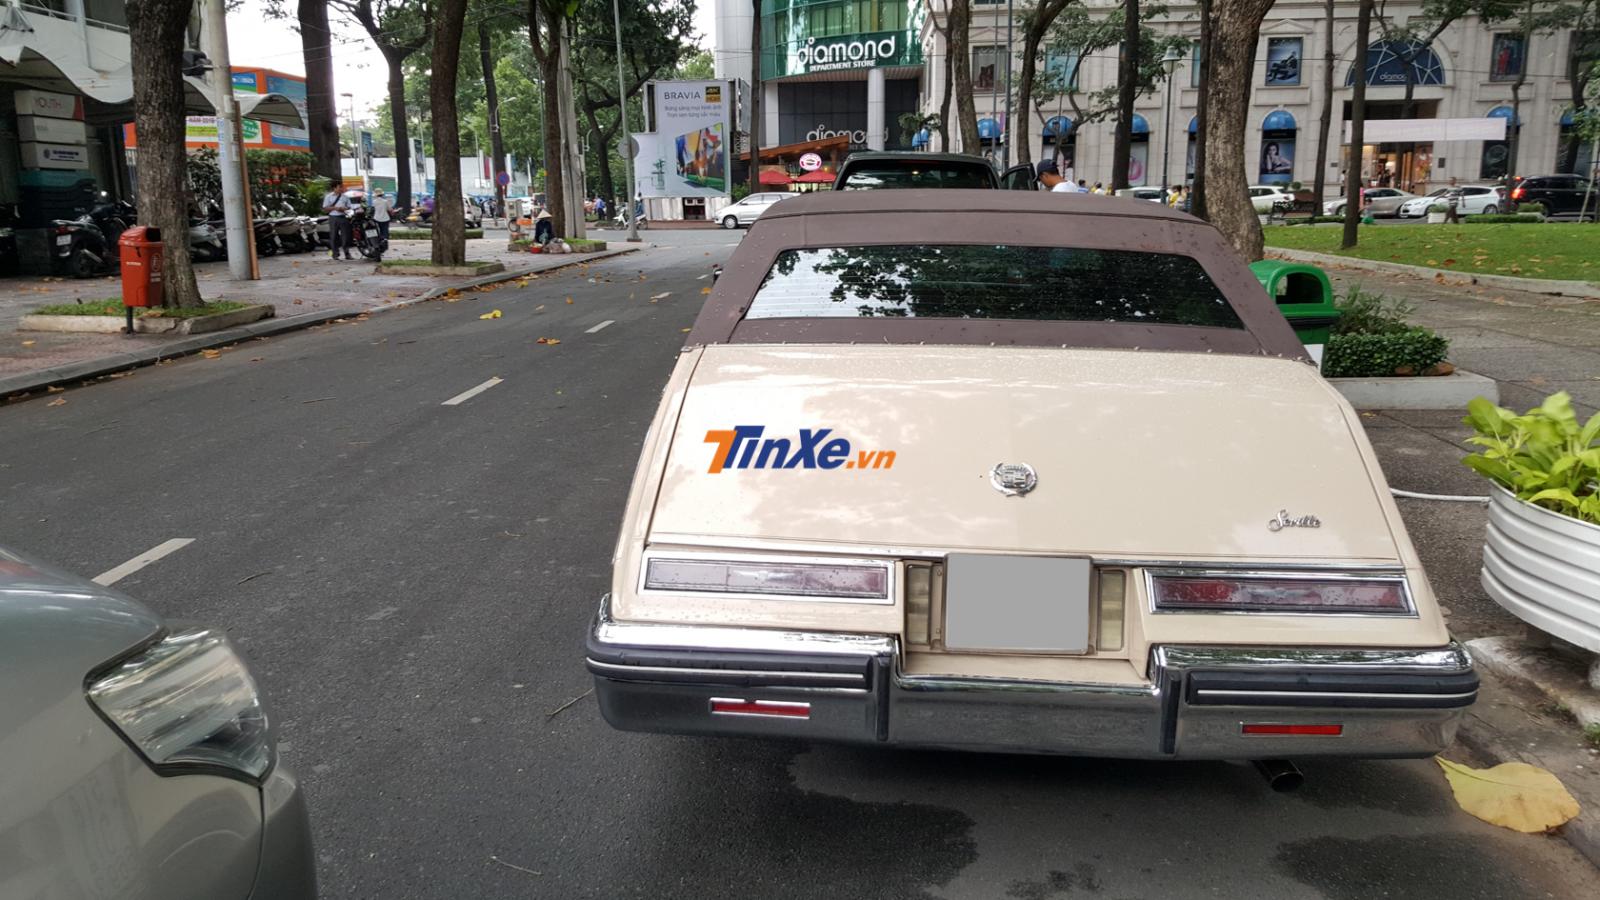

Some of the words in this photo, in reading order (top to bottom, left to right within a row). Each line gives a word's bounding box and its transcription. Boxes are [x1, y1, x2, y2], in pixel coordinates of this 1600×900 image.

[797, 36, 896, 66] diamond
[809, 61, 852, 72] DEPARTMENT
[853, 59, 876, 68] STORE
[664, 91, 701, 100] BRAVIA
[806, 124, 889, 144] diamod
[1267, 509, 1321, 532] Seville
